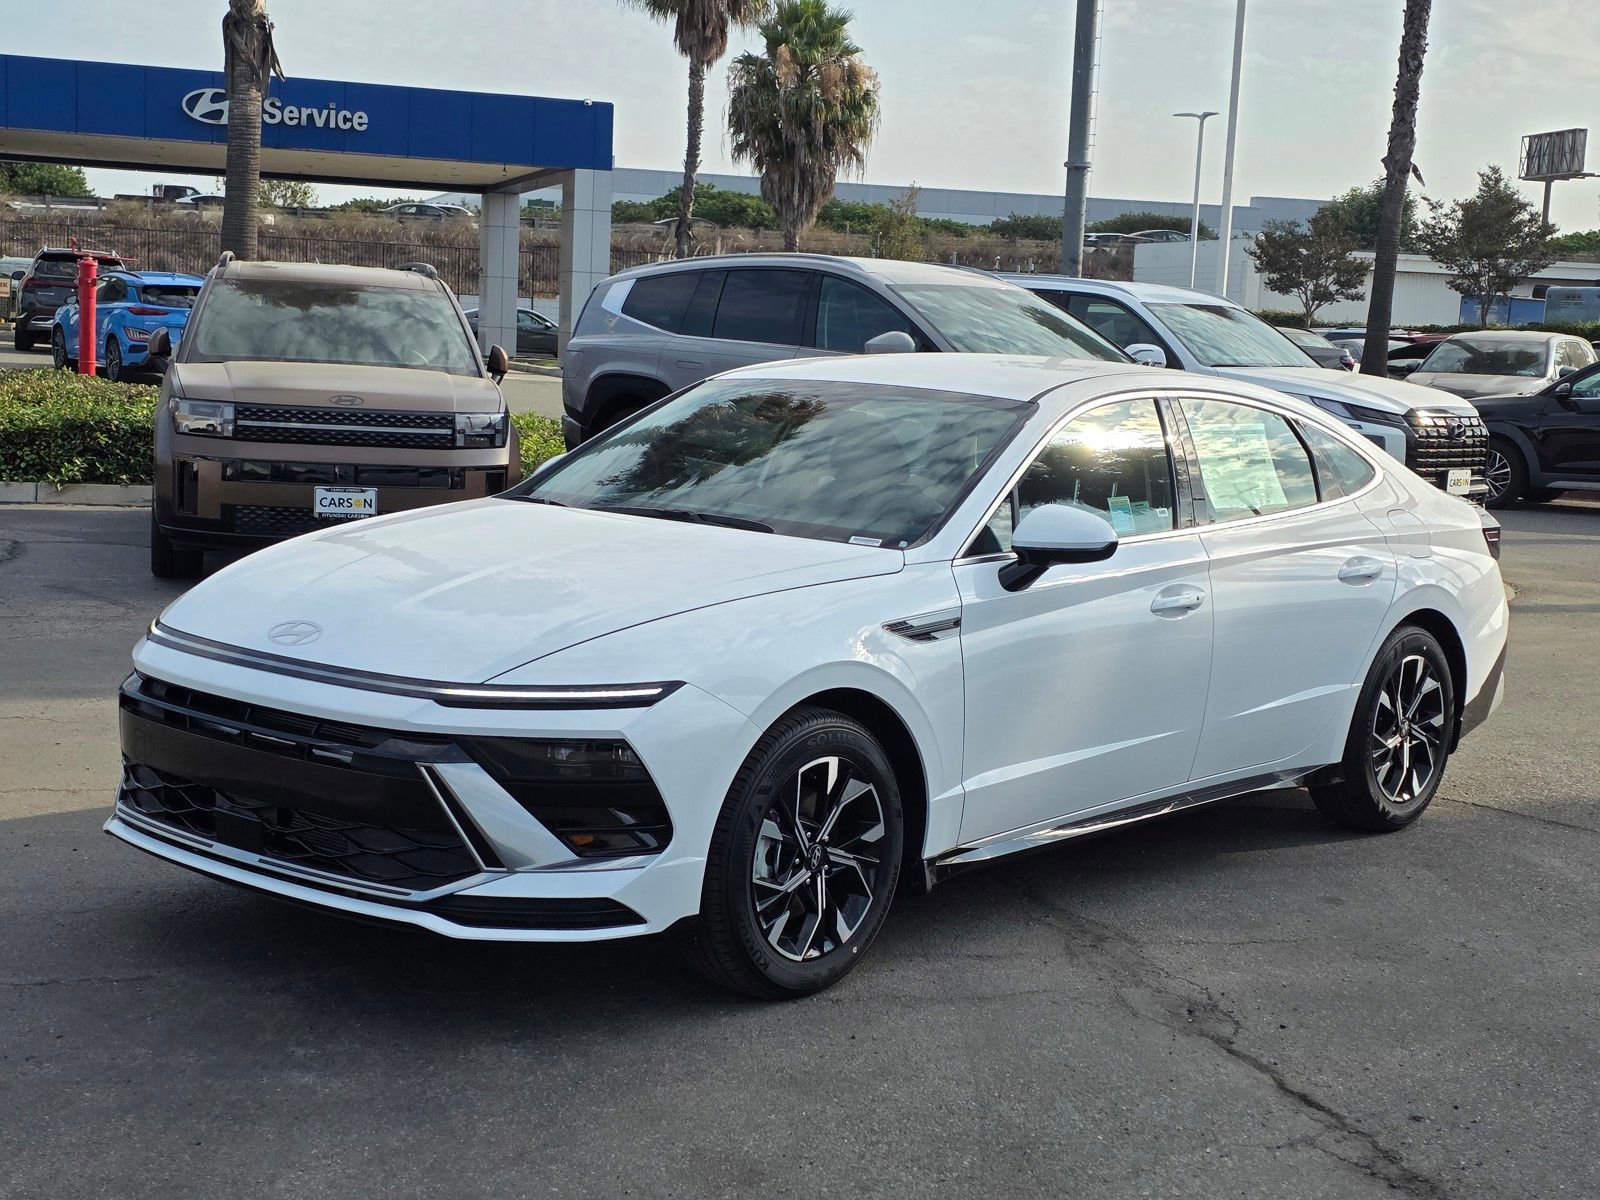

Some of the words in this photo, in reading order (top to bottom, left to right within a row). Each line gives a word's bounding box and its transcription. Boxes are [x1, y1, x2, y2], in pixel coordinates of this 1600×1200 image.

[262, 97, 369, 131] Service
[1449, 478, 1469, 487] CARSON
[319, 497, 372, 509] CARSON
[807, 732, 857, 748] SOLUS
